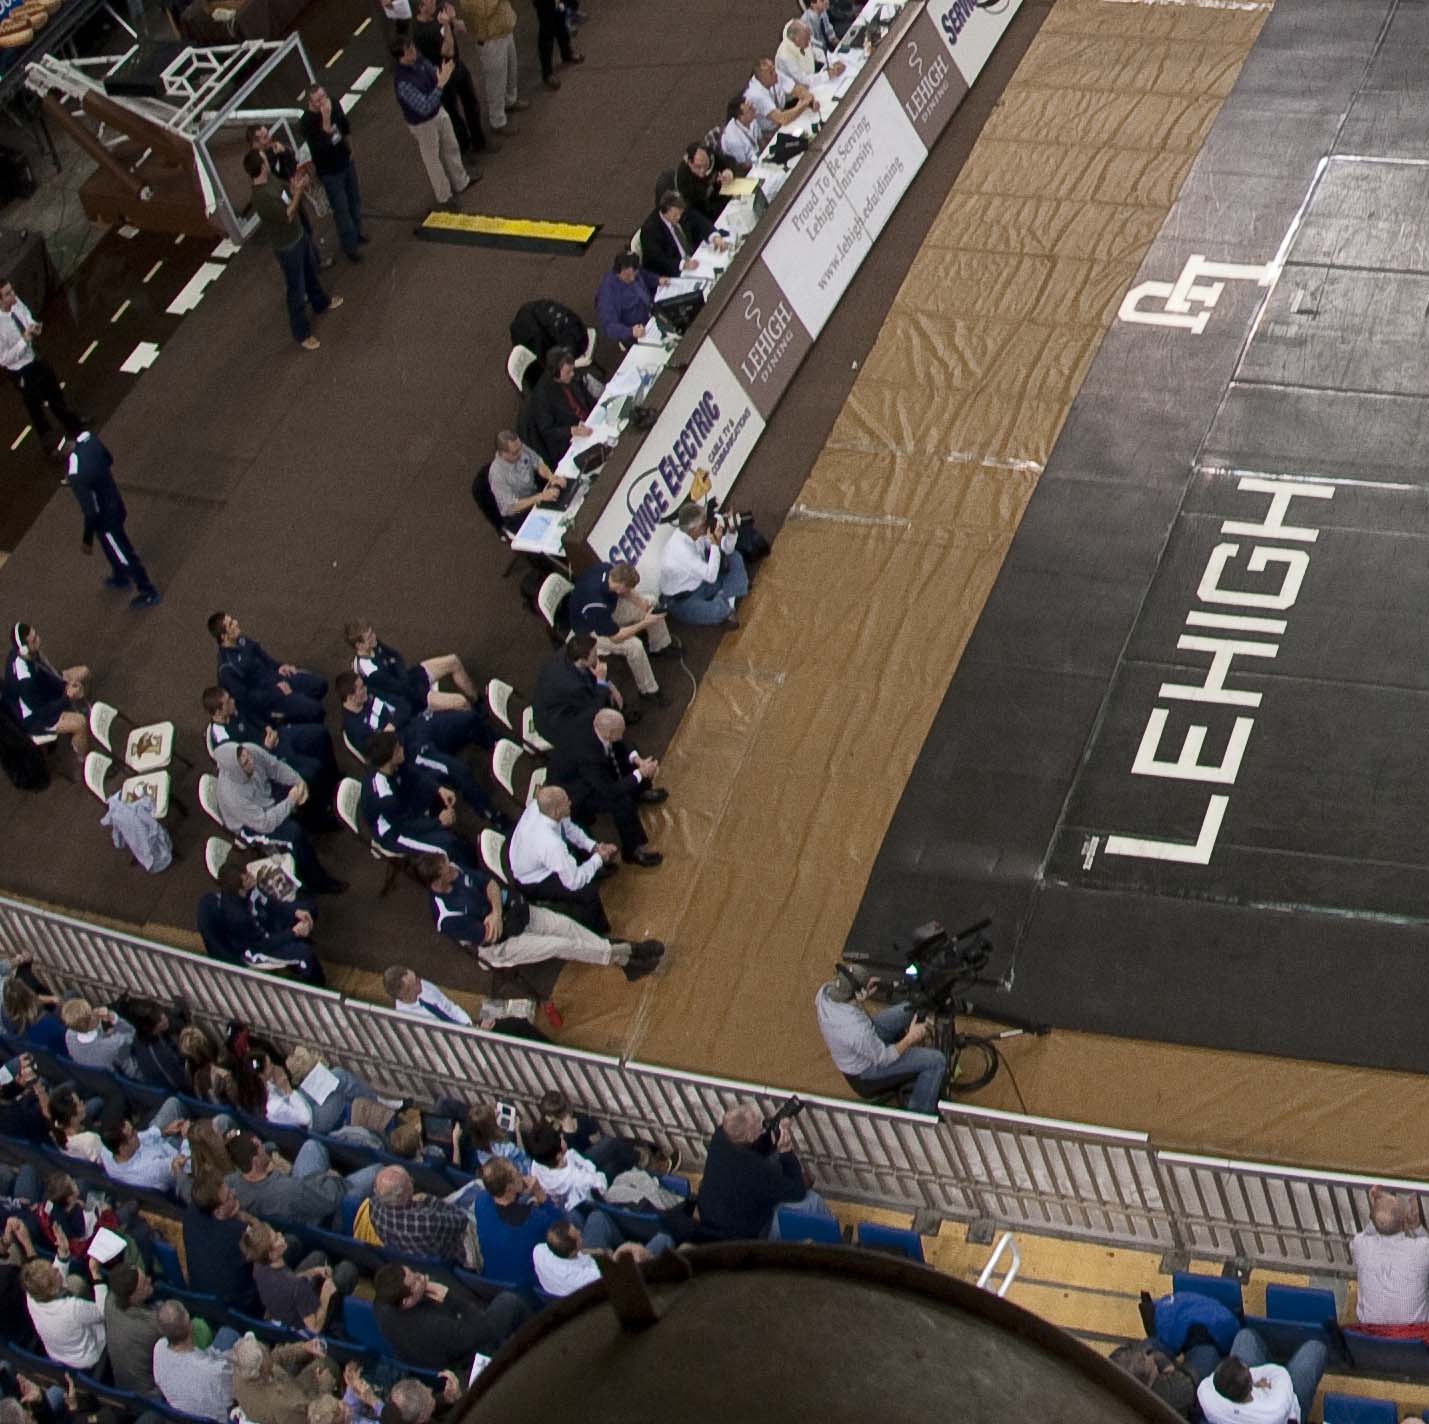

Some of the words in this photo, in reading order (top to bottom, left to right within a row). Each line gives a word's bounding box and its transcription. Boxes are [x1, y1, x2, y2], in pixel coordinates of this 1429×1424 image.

[906, 54, 950, 122] LEHIGH
[921, 81, 950, 124] DINING
[791, 191, 818, 233] Proud
[817, 177, 831, 196] To
[827, 157, 841, 180] Be
[838, 113, 873, 163] Serving
[806, 194, 840, 244] Lehigh
[835, 140, 875, 208] University
[818, 153, 905, 291] www.lehigh.edu/dining
[741, 300, 793, 385] LEHIGH
[761, 330, 795, 384] DINING
[609, 479, 669, 568] SERVICE
[658, 390, 721, 498] ELECTRIC
[1105, 476, 1336, 865] LEHIGH
